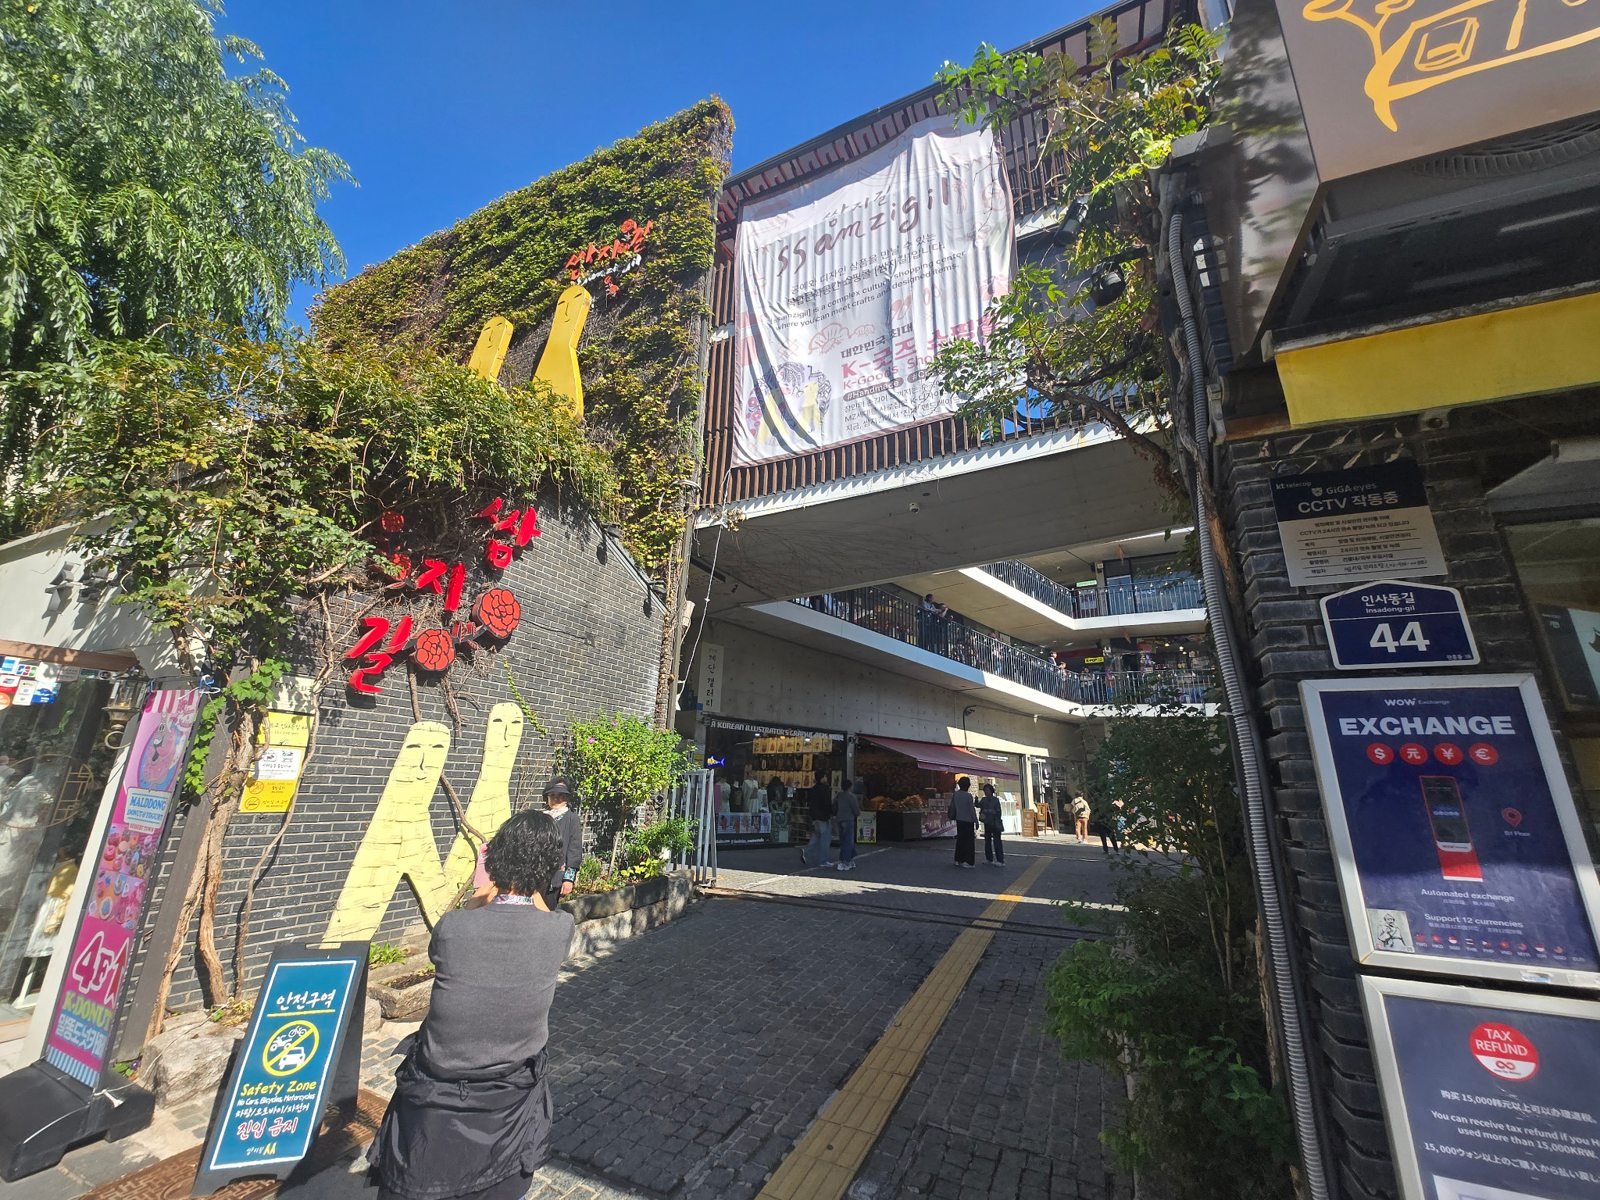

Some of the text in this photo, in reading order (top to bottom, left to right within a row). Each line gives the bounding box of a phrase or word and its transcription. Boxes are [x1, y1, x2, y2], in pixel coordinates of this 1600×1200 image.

[827, 291, 861, 308] complex
[893, 262, 934, 279] shopping
[851, 294, 876, 308] crafts
[892, 269, 931, 290] designed
[840, 334, 887, 359] 대한민국
[1297, 490, 1399, 514] CCTV 작동중
[1361, 592, 1416, 607] 인사동길
[1366, 605, 1415, 614] Insadong-gil
[1369, 621, 1430, 653] 44
[1338, 715, 1516, 736] EXCHANGE
[1421, 888, 1516, 902] Automated exchange
[1424, 913, 1461, 925] Support
[1475, 919, 1524, 929] currencies
[276, 989, 336, 1011] 안전구역
[1484, 1028, 1512, 1042] TAX
[1475, 1039, 1528, 1057] REFUND
[241, 1080, 316, 1096] Safety Zone
[283, 1092, 316, 1102] Motorcycles
[237, 1116, 299, 1140] 진입 금지
[1431, 1109, 1450, 1122] You
[1450, 1115, 1468, 1125] can
[1469, 1118, 1505, 1131] receive
[1506, 1123, 1522, 1133] tax
[1524, 1126, 1559, 1140] refund
[1559, 1131, 1568, 1141] if
[1568, 1135, 1590, 1145] you
[1458, 1126, 1599, 1159] used more than 15,000KRW.
